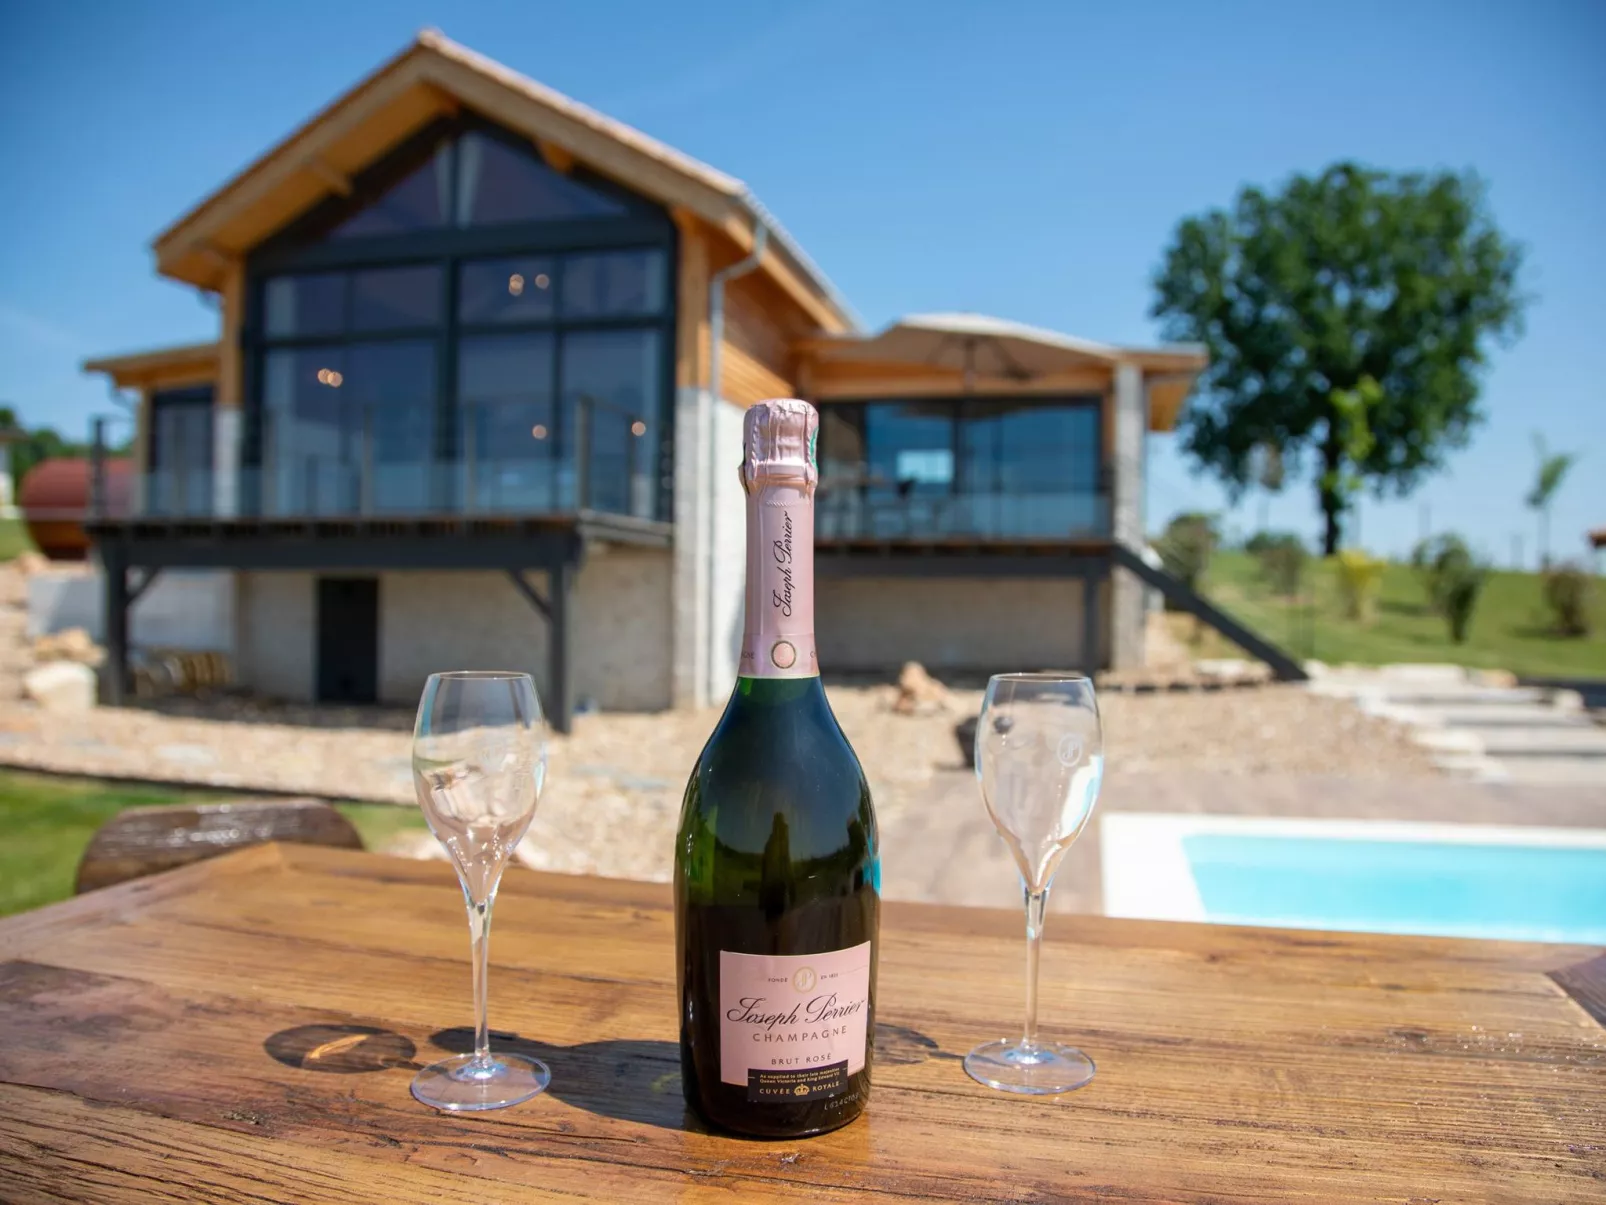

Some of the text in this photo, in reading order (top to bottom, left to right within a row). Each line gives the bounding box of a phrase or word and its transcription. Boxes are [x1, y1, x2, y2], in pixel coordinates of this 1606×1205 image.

[773, 510, 795, 617] Joseph Perrier
[726, 993, 866, 1031] Joseph Perrier
[752, 1025, 848, 1043] CHAMPAGNE
[771, 1057, 800, 1065] BRUT
[812, 1081, 840, 1092] ROYALE
